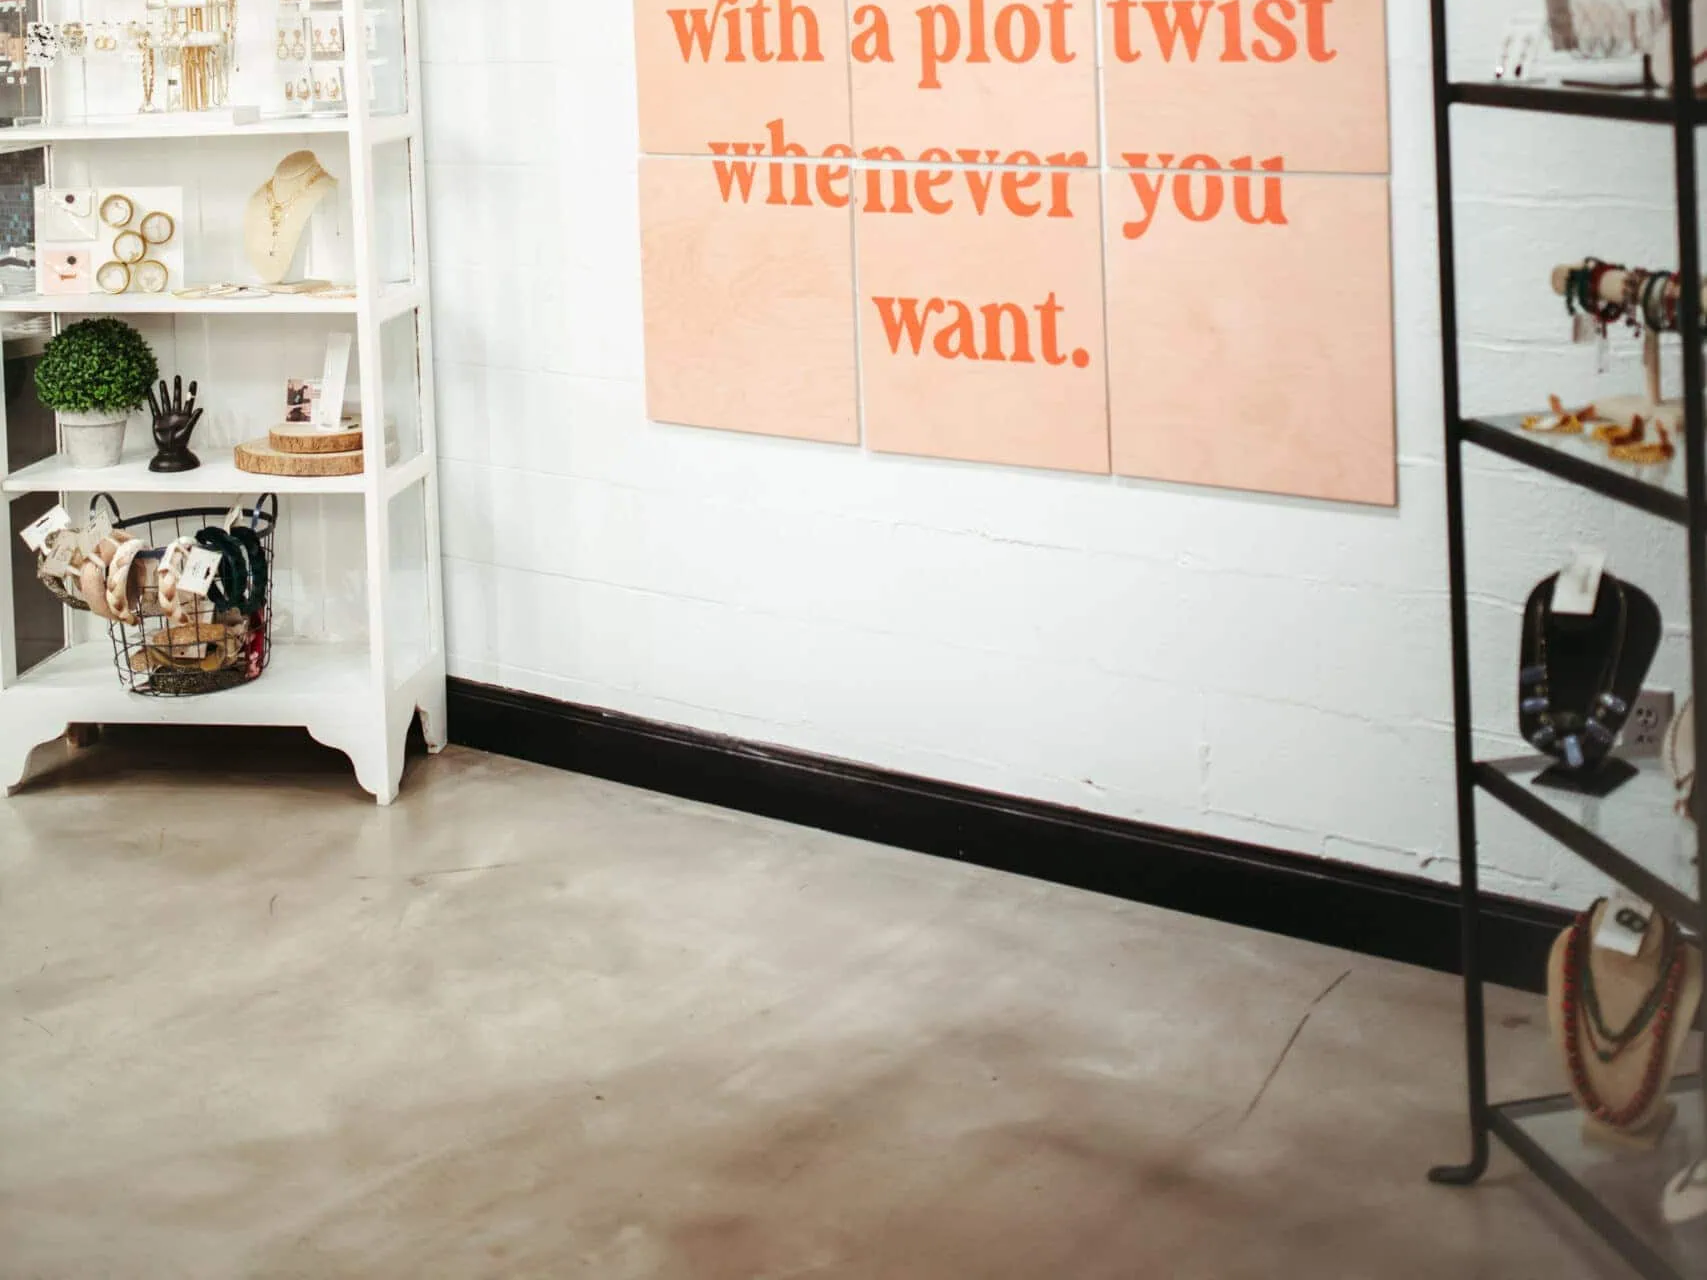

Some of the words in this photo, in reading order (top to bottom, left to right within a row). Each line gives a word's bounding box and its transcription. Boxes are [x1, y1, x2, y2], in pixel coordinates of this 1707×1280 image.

[852, 5, 893, 63] a
[708, 119, 1088, 218] whenever
[1122, 151, 1288, 240] you
[873, 293, 1091, 369] want.
